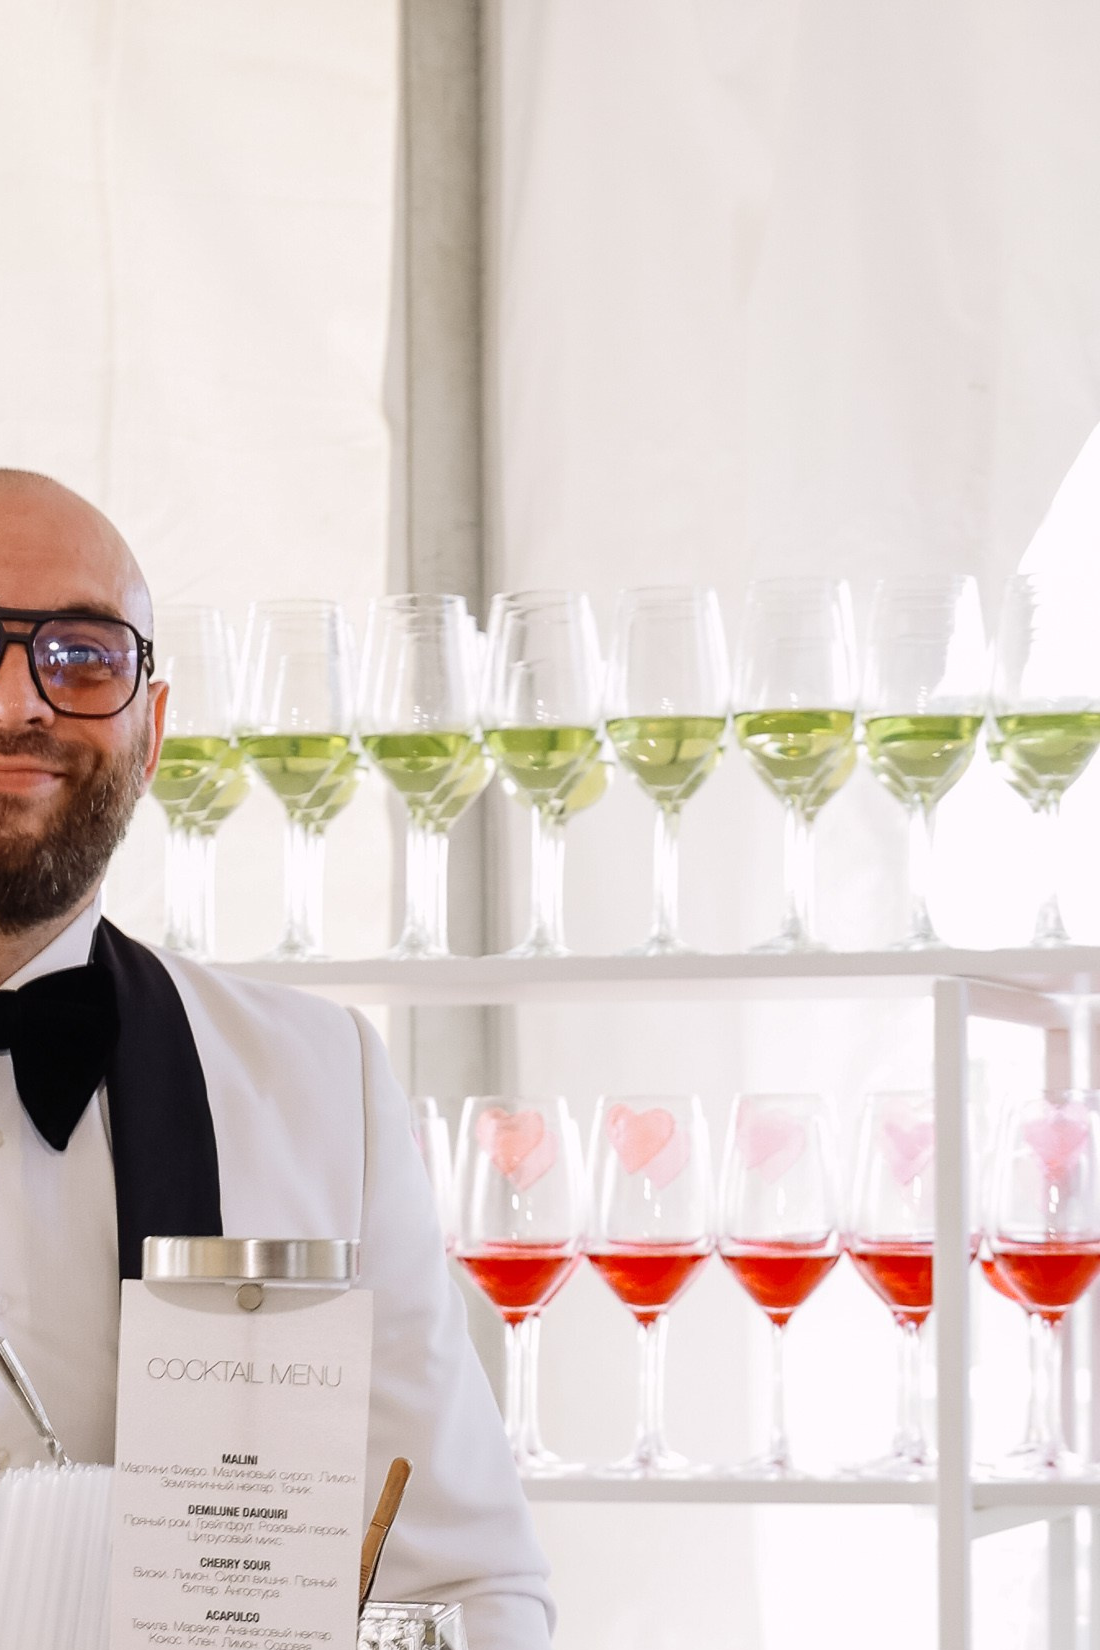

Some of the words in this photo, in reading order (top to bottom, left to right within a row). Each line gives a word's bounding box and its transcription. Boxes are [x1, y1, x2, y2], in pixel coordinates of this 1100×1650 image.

[148, 1357, 264, 1384] COCKTAIL
[270, 1363, 342, 1387] MENU
[222, 1454, 258, 1465] MALINI
[120, 1462, 168, 1475] Мартини
[213, 1468, 276, 1480] Малиновый
[161, 1477, 234, 1490] Земляничный
[188, 1505, 240, 1517] DEMILUNE
[243, 1507, 288, 1519] DAIQUIRI
[124, 1514, 166, 1527] Пряный
[259, 1522, 306, 1533] Розовый
[188, 1531, 252, 1544] Цитрусовый
[200, 1557, 240, 1569] CHERRY
[243, 1559, 270, 1571] SOUR
[215, 1571, 249, 1584] Сироп
[294, 1575, 336, 1588] Пряный
[205, 1610, 260, 1623] ACAPULCO
[226, 1625, 291, 1638] Ананасовый
